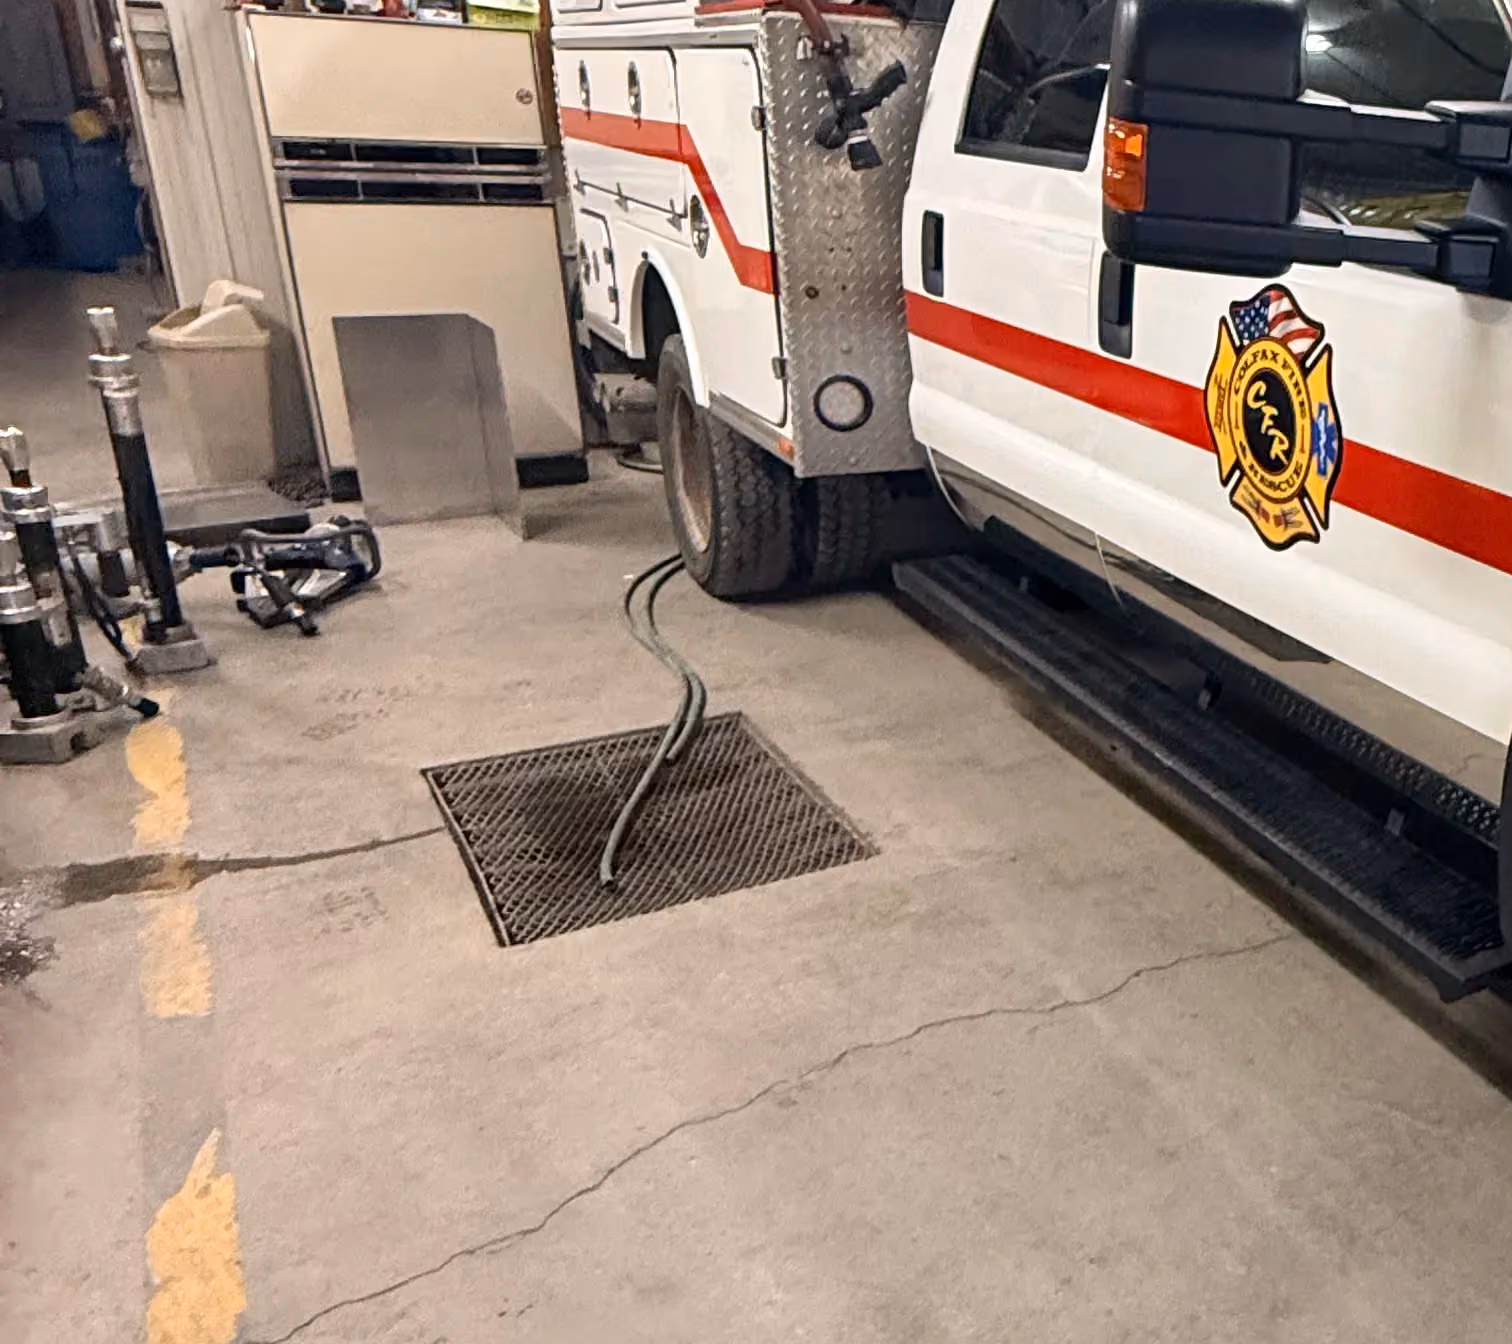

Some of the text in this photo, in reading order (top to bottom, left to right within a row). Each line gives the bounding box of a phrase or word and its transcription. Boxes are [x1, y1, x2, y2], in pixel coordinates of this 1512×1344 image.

[1234, 348, 1307, 420] COLFAX FIRE
[1246, 380, 1290, 465] CFR
[1248, 460, 1304, 493] RESCUE
